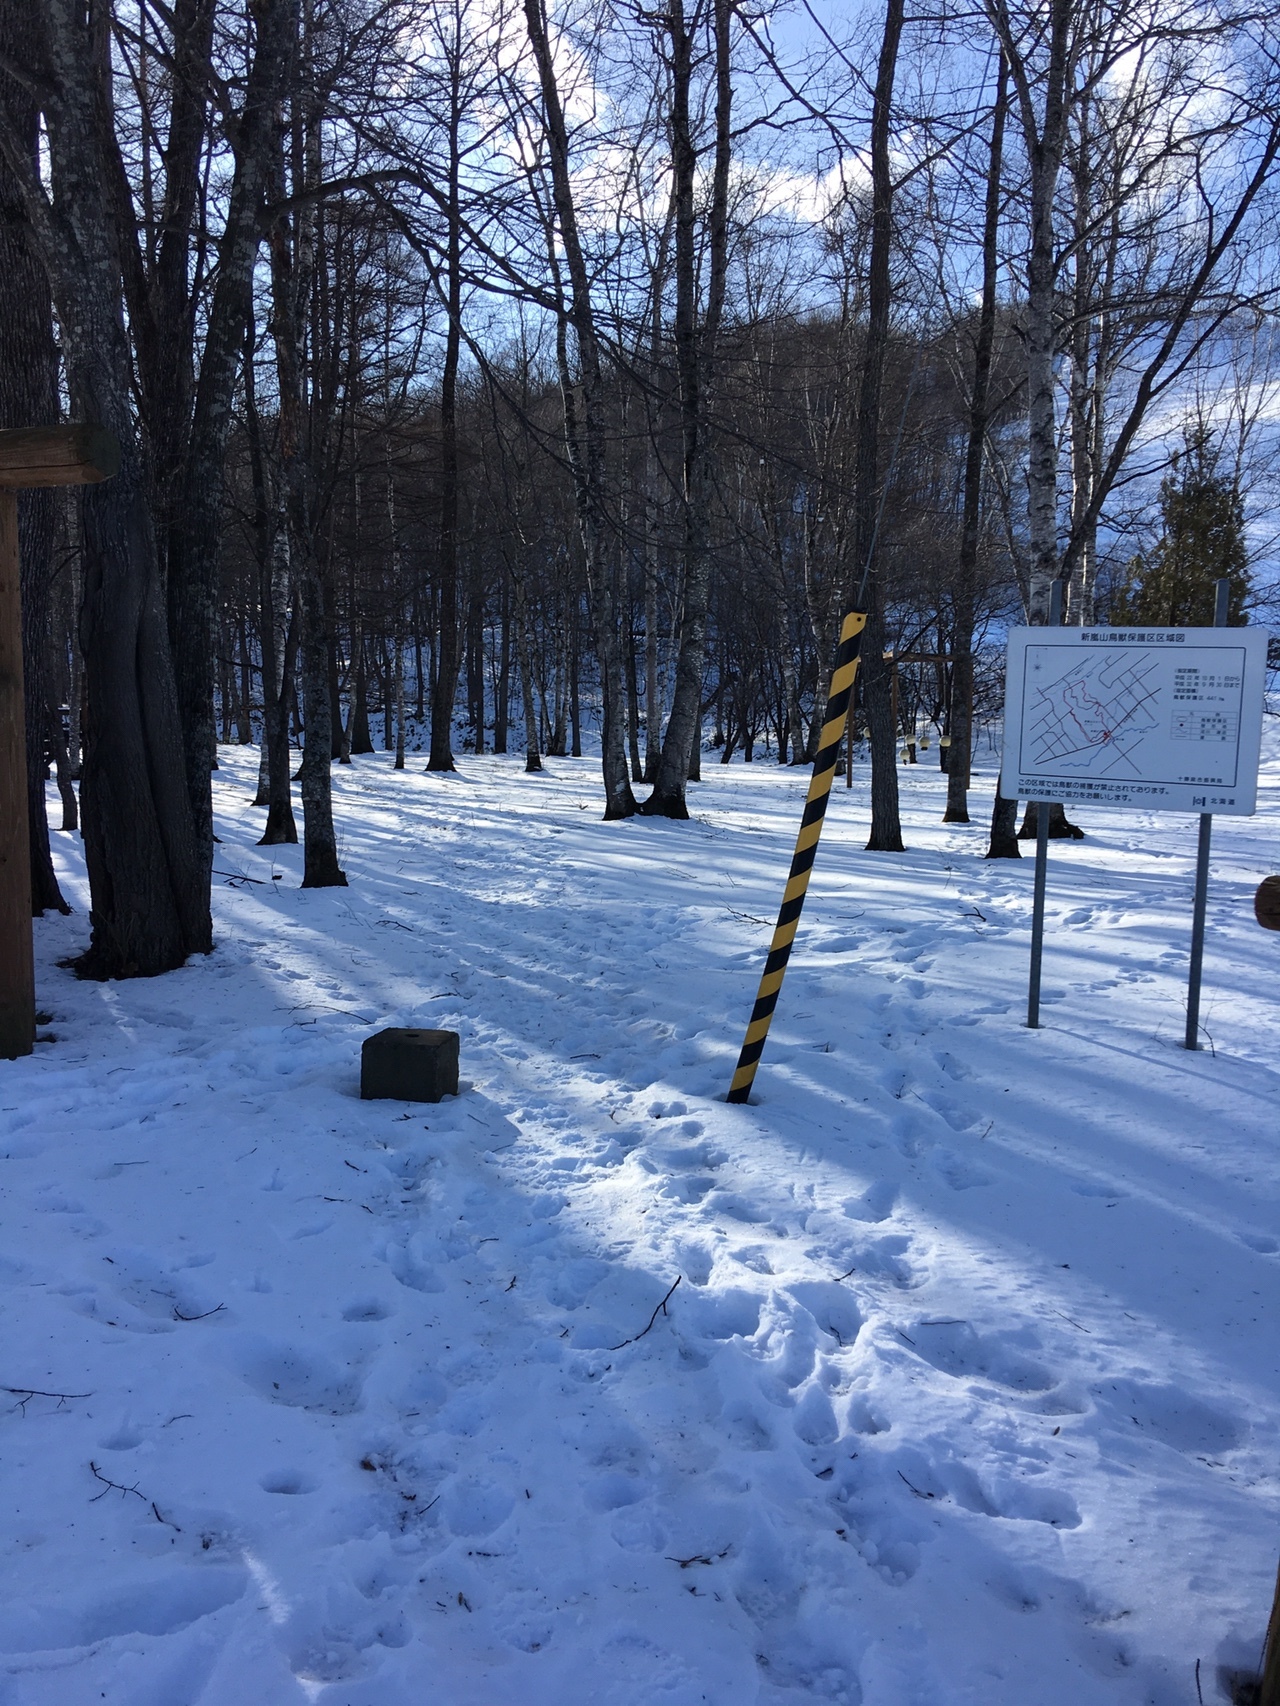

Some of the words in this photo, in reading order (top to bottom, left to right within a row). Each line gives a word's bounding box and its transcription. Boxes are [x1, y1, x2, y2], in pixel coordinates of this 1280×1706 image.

[1081, 632, 1186, 643] 新嵐山鳥獣保護区区域図
[1017, 788, 1132, 802] 鳥獣の保護にご協力をお願いします。
[1210, 797, 1236, 806] 北海道
